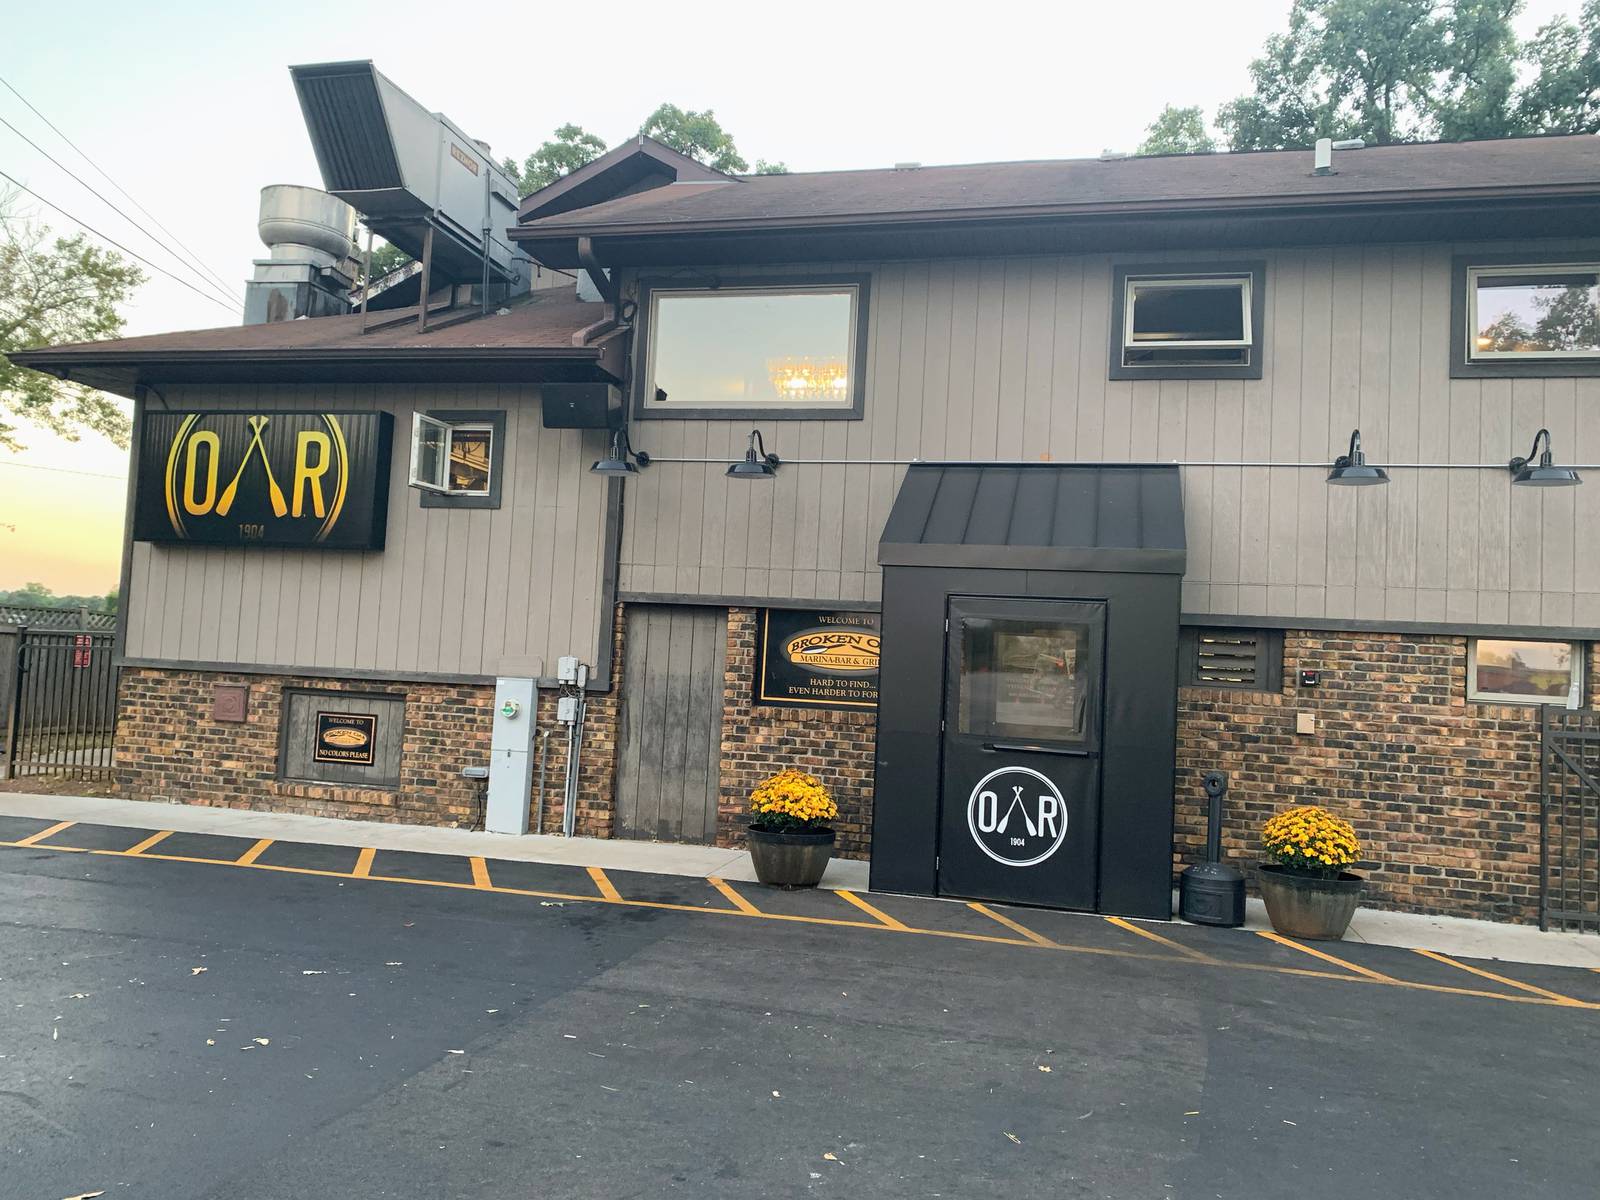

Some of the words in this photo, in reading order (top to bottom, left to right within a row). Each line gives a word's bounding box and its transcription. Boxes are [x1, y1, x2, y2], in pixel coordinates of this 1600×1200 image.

[240, 524, 264, 539] 1904
[818, 616, 860, 624] WELCOME
[791, 634, 863, 652] BROKEN
[867, 639, 880, 648] O
[810, 678, 834, 687] HARD
[849, 680, 876, 689] FIND...
[788, 686, 811, 695] EVEN
[812, 688, 847, 697] HARDER
[1010, 837, 1025, 846] 1904
